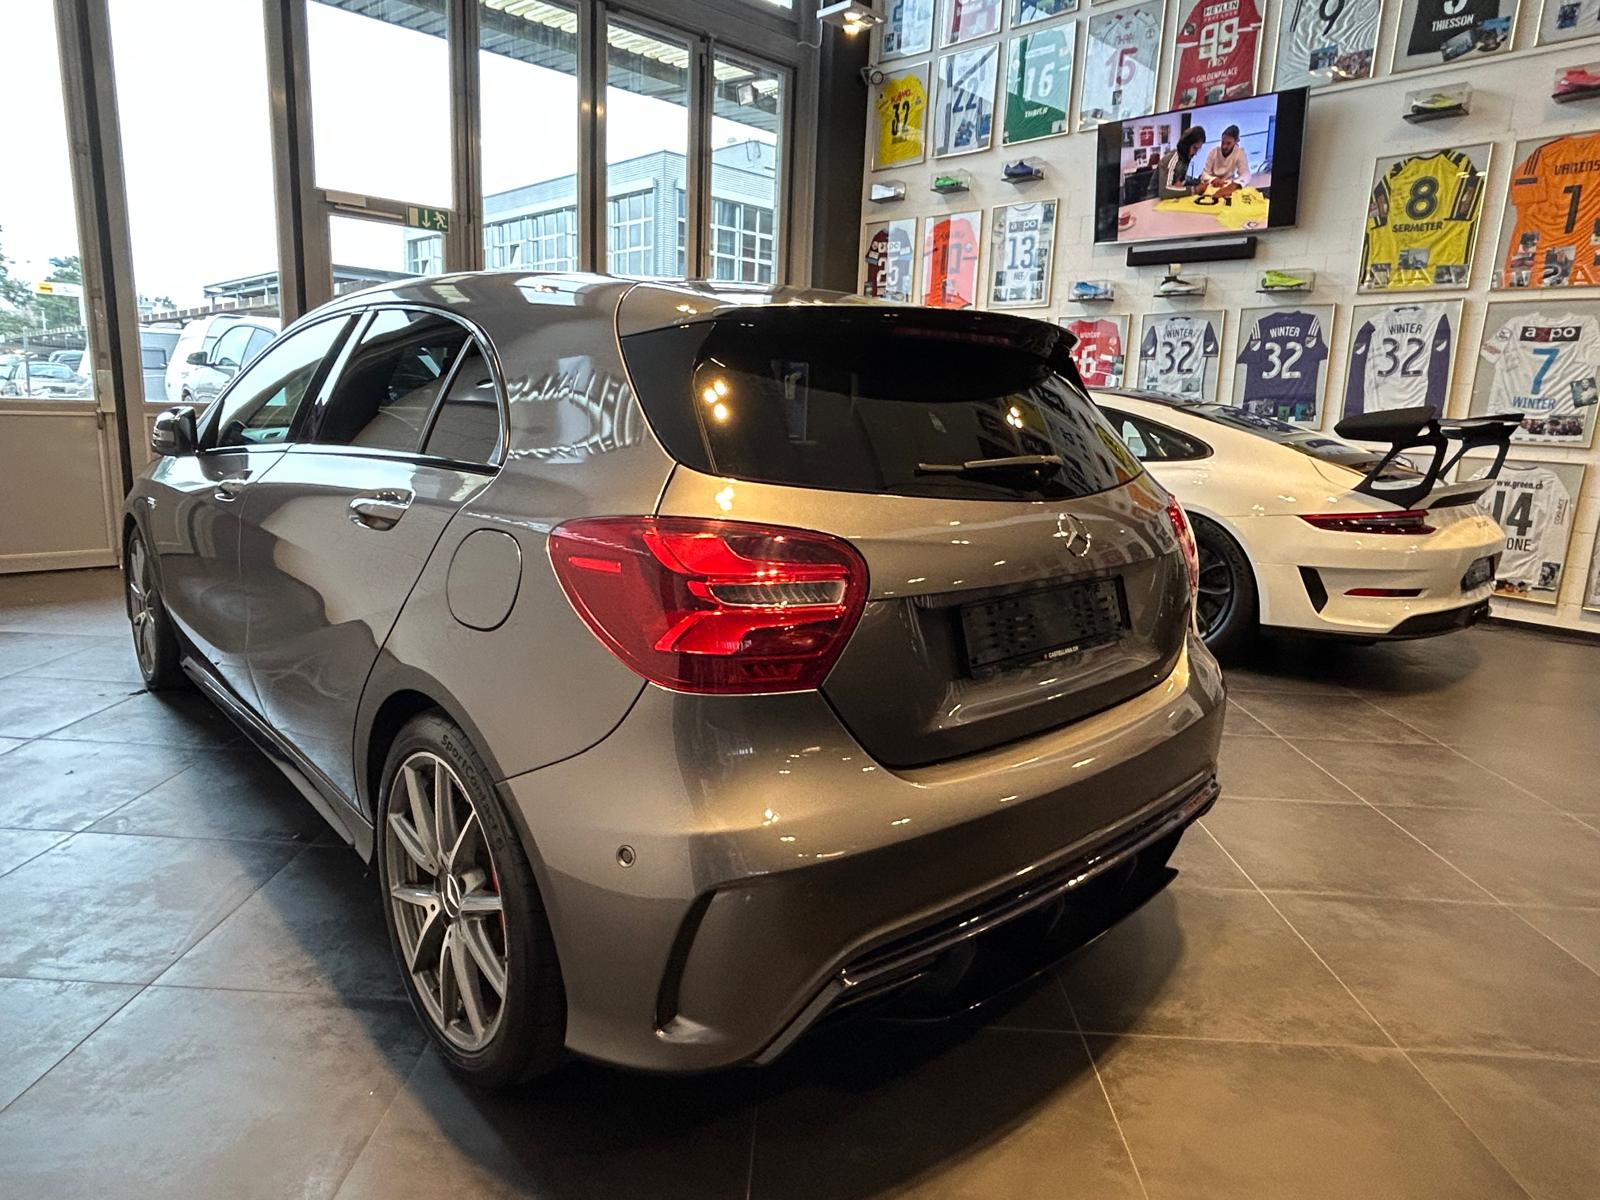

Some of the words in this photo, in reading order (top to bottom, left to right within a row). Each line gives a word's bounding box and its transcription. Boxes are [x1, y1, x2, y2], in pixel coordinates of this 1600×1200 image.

[1205, 1, 1238, 16] HEYLEN
[1431, 14, 1474, 32] THIESSON
[1199, 17, 1240, 60] 99
[1025, 62, 1055, 101] 16
[1105, 47, 1138, 87] 15
[1405, 176, 1439, 220] 8
[1563, 184, 1583, 234] 1
[1392, 221, 1444, 233] SERMETER
[1007, 236, 1036, 270] 13
[1167, 328, 1194, 339] WINTER
[1269, 326, 1301, 338] WINTER
[1388, 324, 1423, 336] WINTER
[1160, 341, 1195, 375] 32
[1262, 342, 1303, 379] 32
[1377, 338, 1426, 378] 32
[1530, 347, 1560, 395] 7
[1512, 396, 1556, 410] WINTER
[1496, 480, 1544, 490] ww.green.ch
[1506, 537, 1532, 552] ONE
